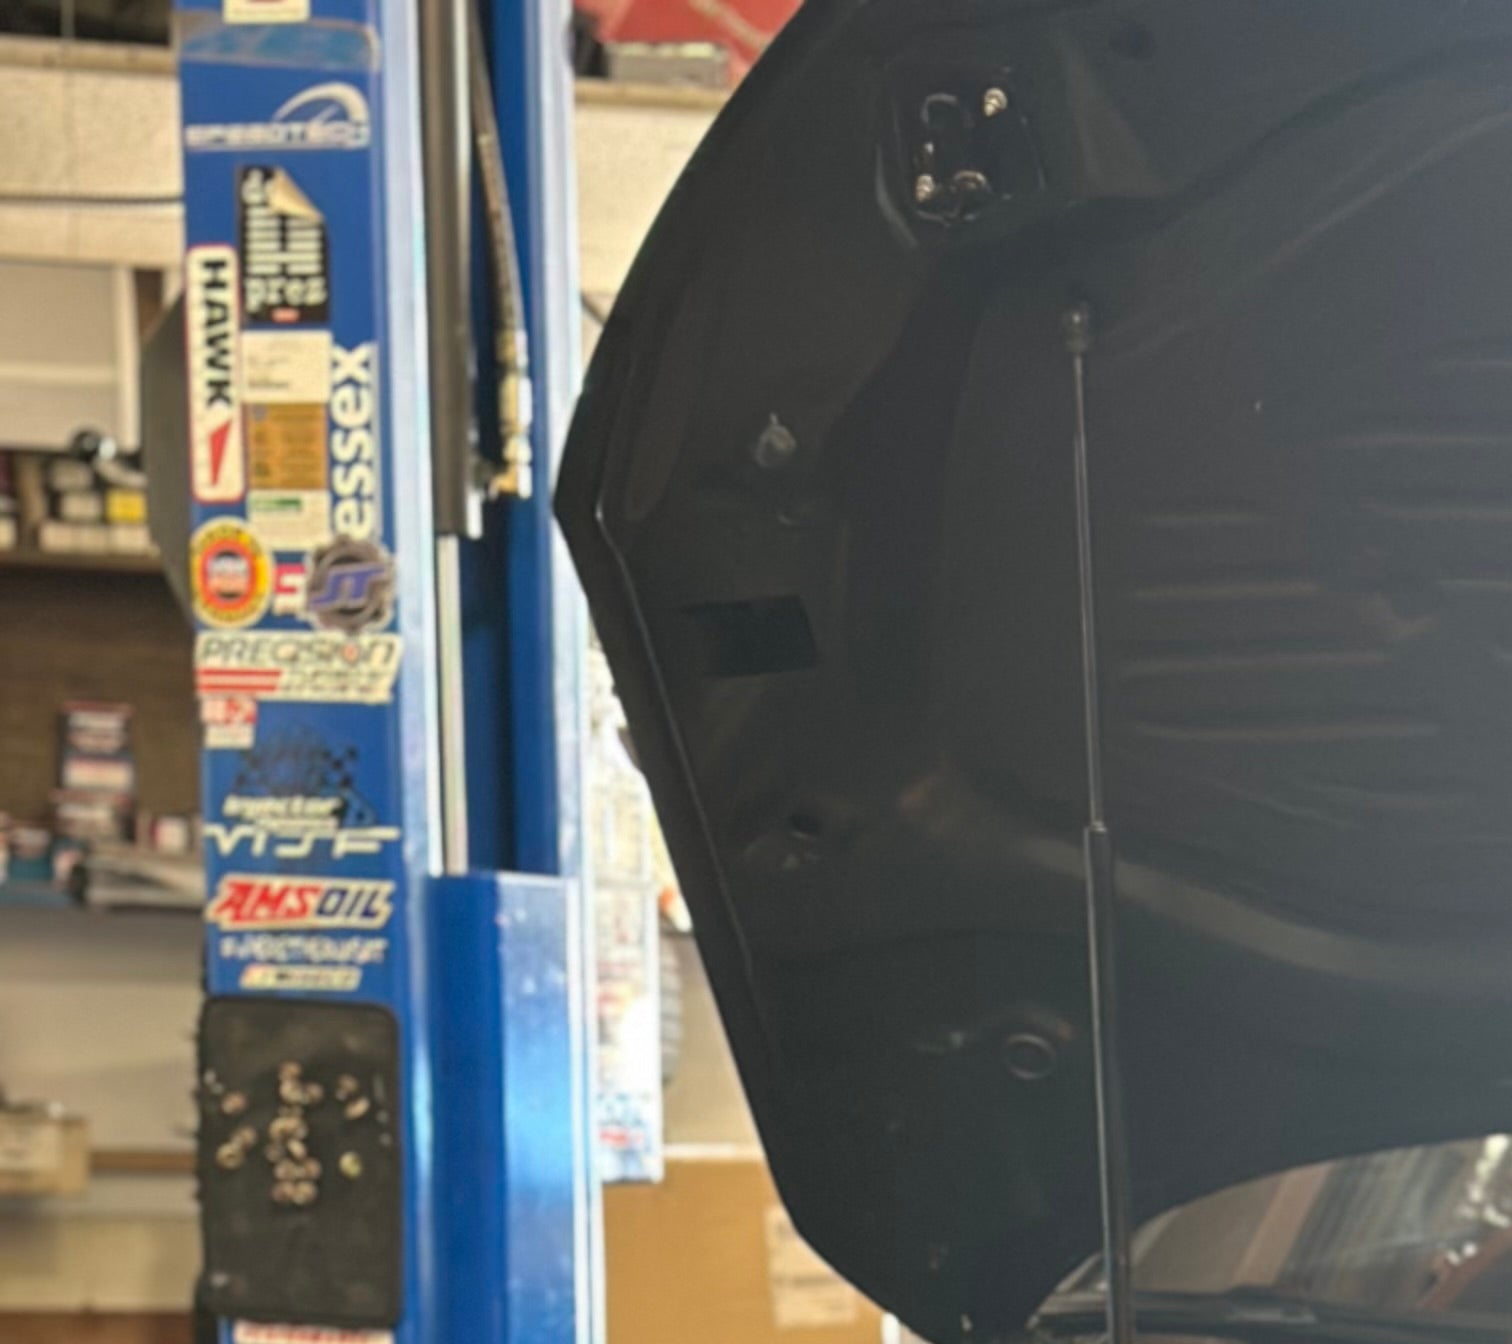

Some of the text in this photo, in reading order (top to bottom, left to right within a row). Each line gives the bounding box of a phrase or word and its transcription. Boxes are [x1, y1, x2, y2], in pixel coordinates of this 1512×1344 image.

[202, 258, 231, 409] HAWK
[332, 342, 374, 541] essex
[213, 879, 380, 922] AMSOIL
